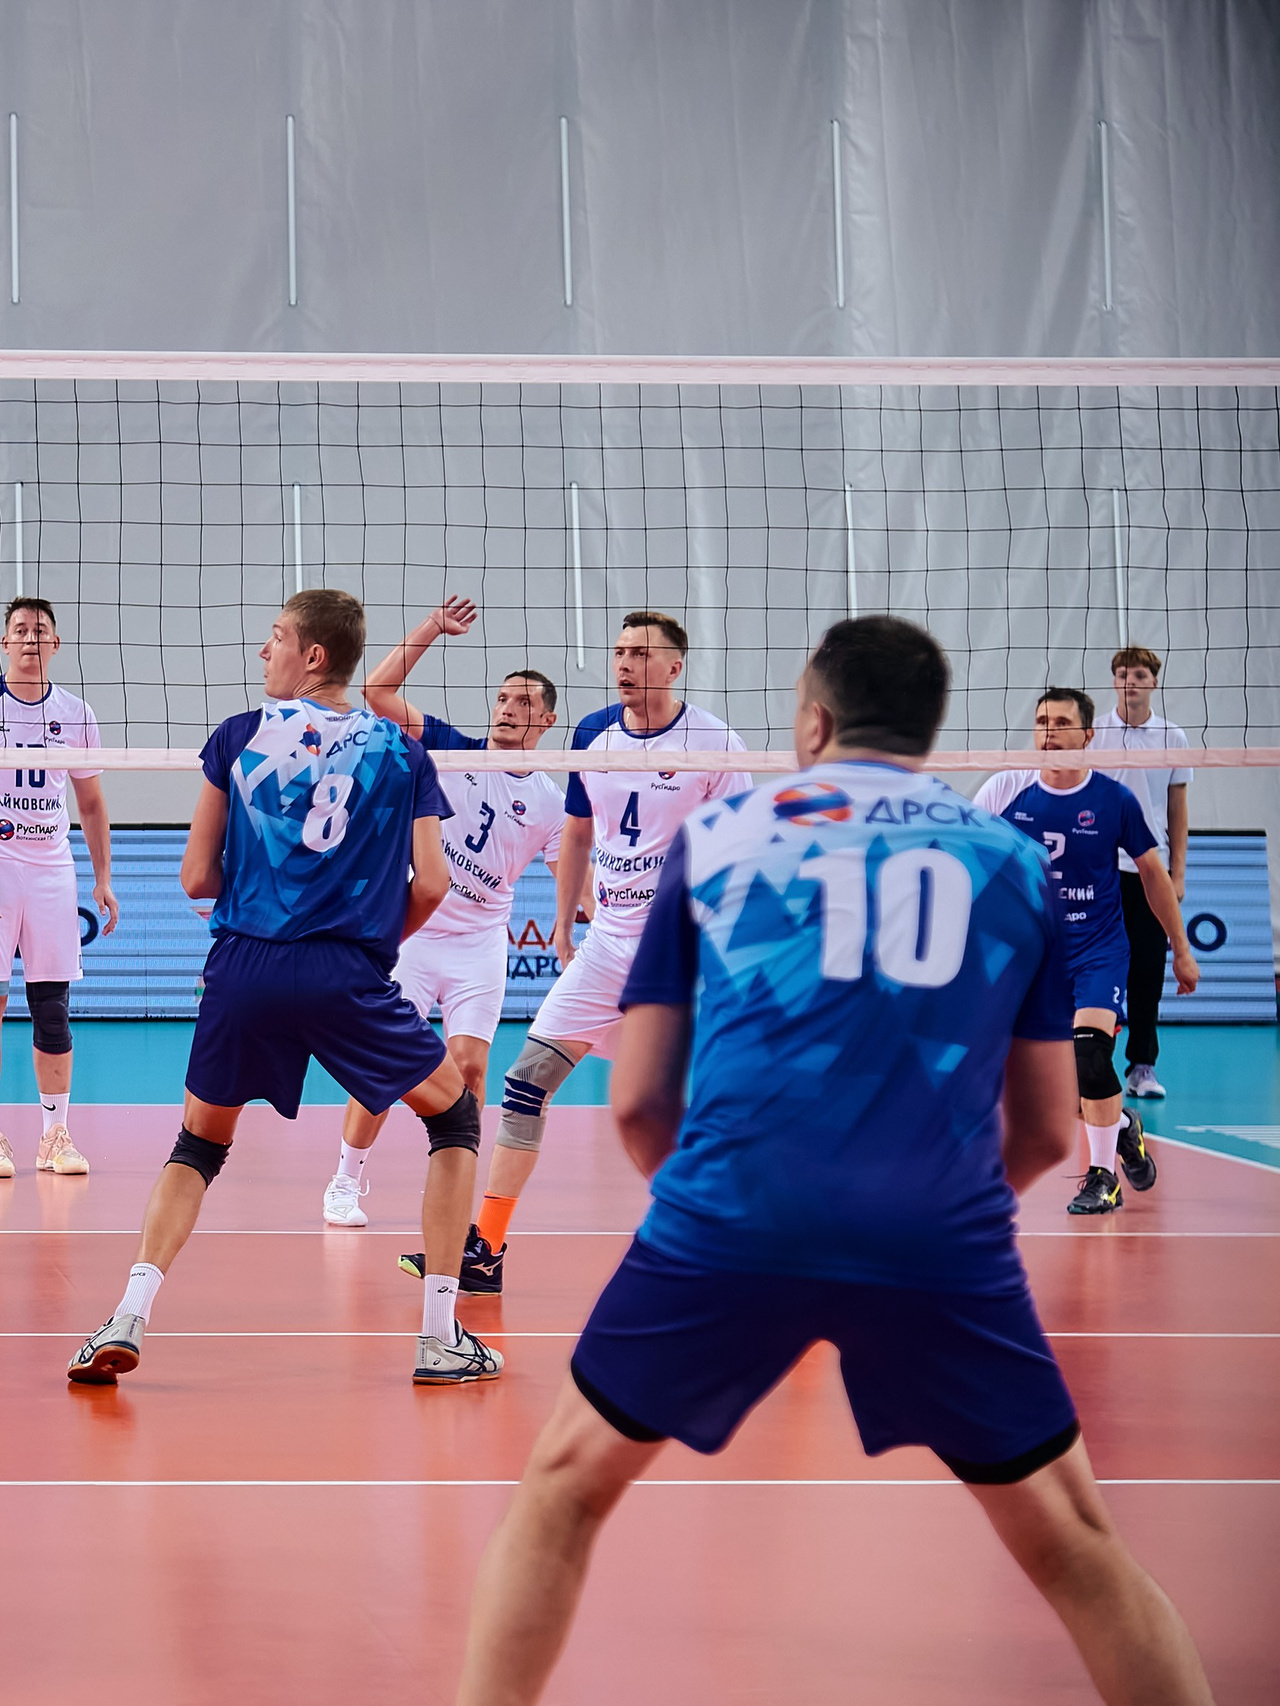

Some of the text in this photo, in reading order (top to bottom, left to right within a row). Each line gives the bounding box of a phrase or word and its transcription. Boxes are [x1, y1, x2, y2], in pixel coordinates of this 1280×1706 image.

[326, 730, 369, 758] ДРС
[302, 773, 355, 853] 8
[464, 801, 496, 854] 3
[619, 791, 642, 847] 4
[865, 796, 984, 828] ДРСК
[608, 888, 655, 901] РусГидр
[798, 847, 973, 989] 10
